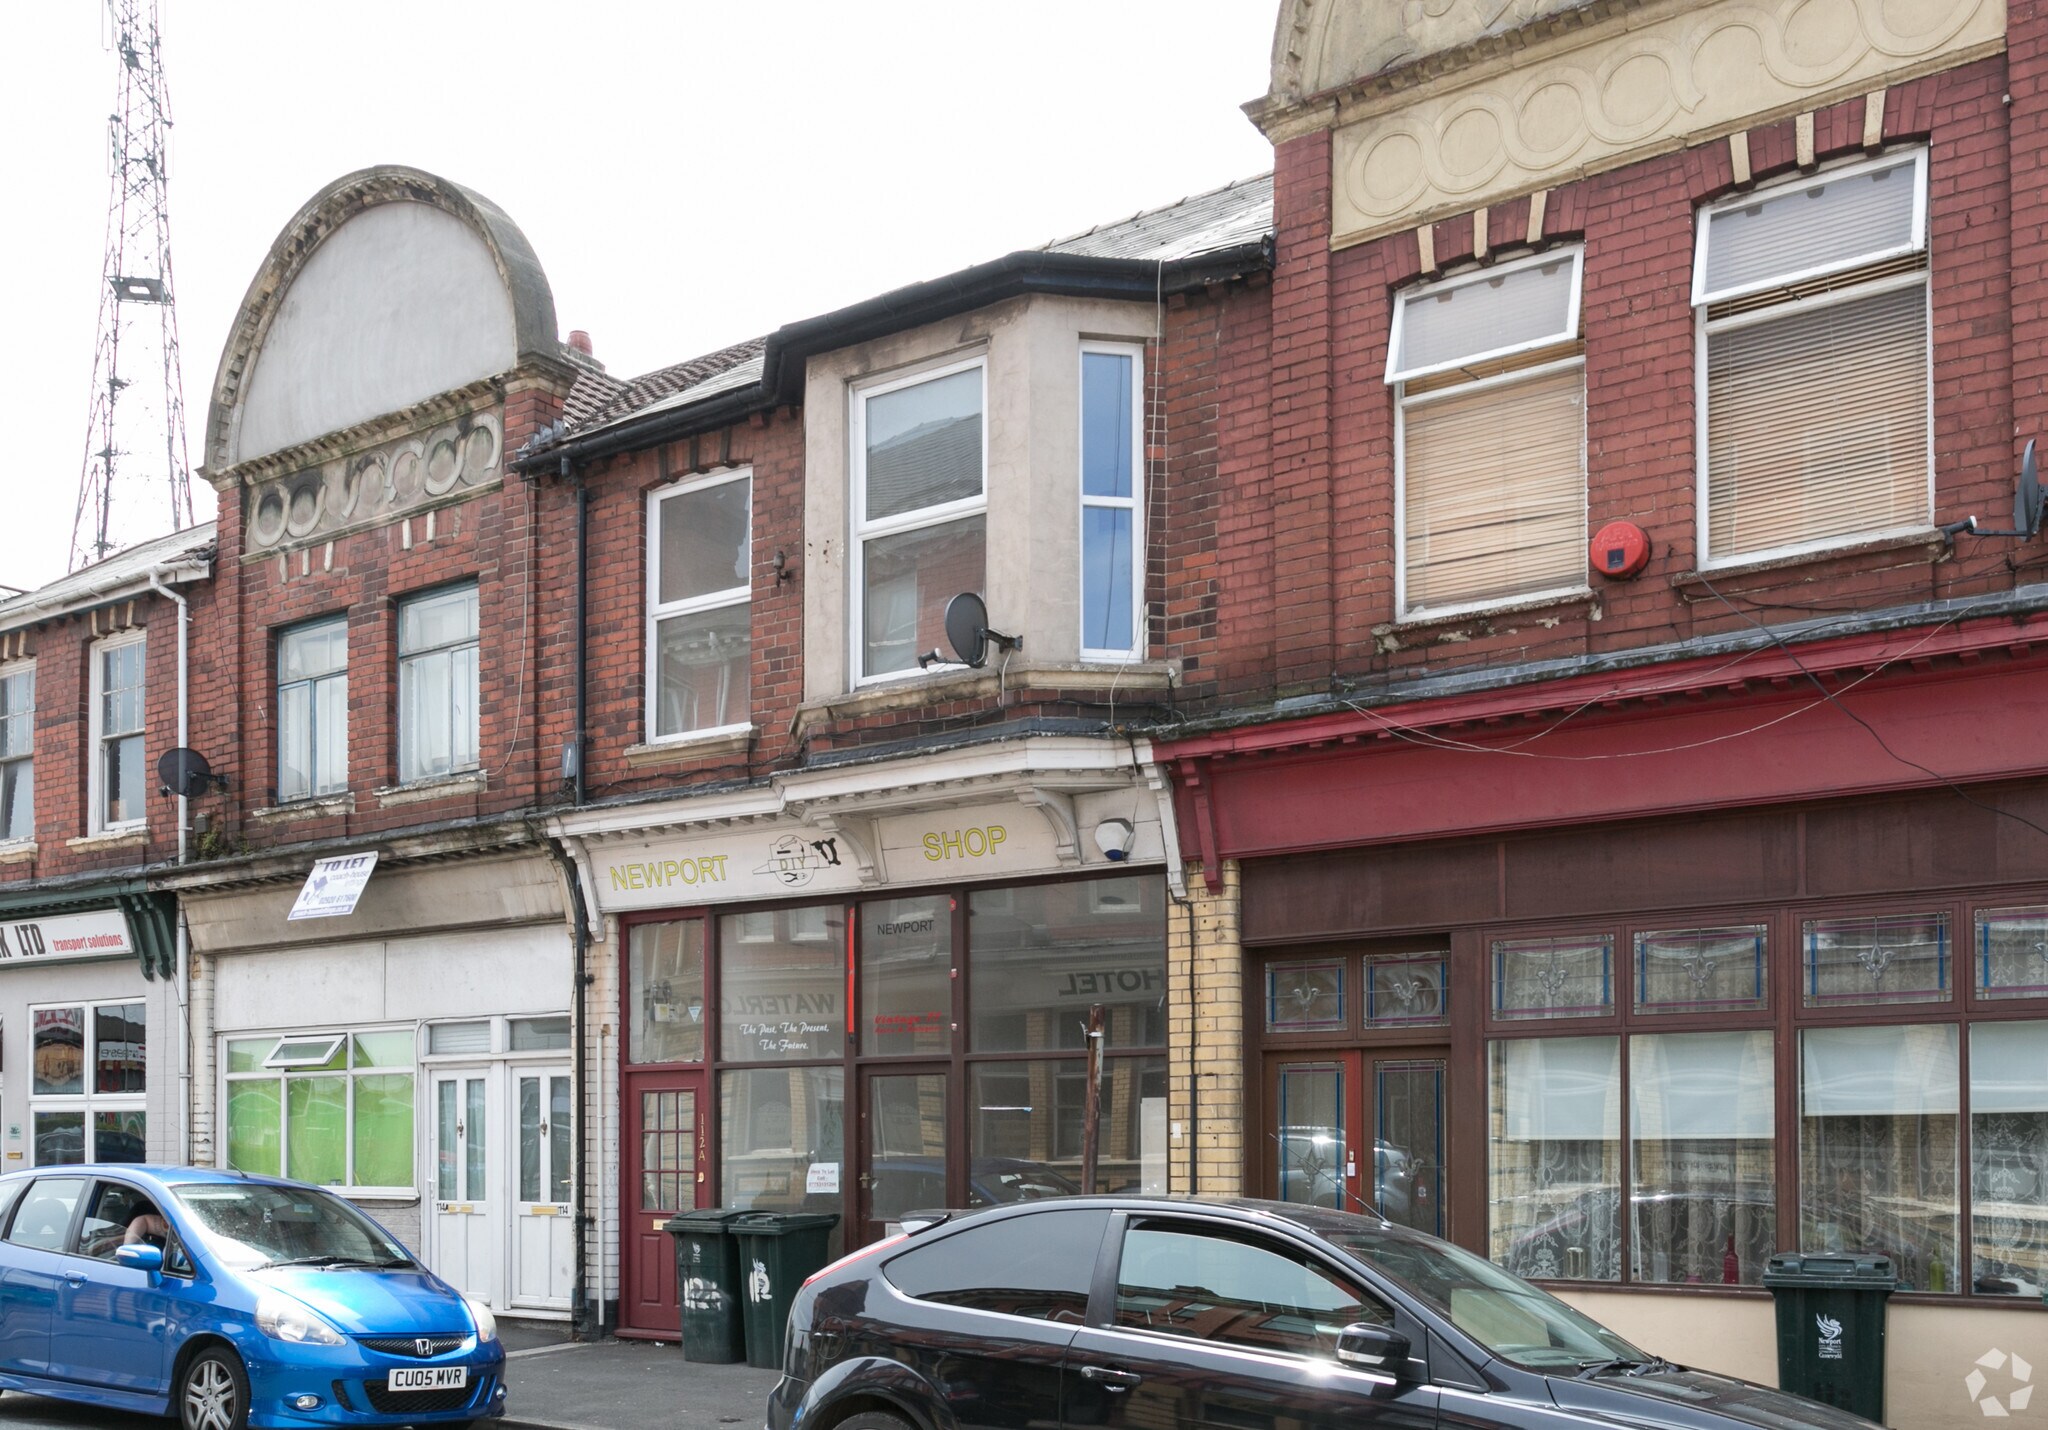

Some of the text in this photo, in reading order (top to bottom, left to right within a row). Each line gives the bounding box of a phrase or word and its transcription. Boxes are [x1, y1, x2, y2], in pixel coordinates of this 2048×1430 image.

[323, 857, 368, 872] TO LET
[610, 855, 728, 890] NEWPORT
[923, 825, 1007, 861] SHOP
[877, 919, 935, 936] NEWPORT
[0, 923, 46, 958] K LTD
[53, 934, 123, 952] transport solutions
[739, 1023, 756, 1035] The
[779, 1021, 797, 1034] The
[759, 1038, 777, 1051] The
[558, 1206, 568, 1215] 114
[395, 1368, 462, 1387] CU05 MVR
